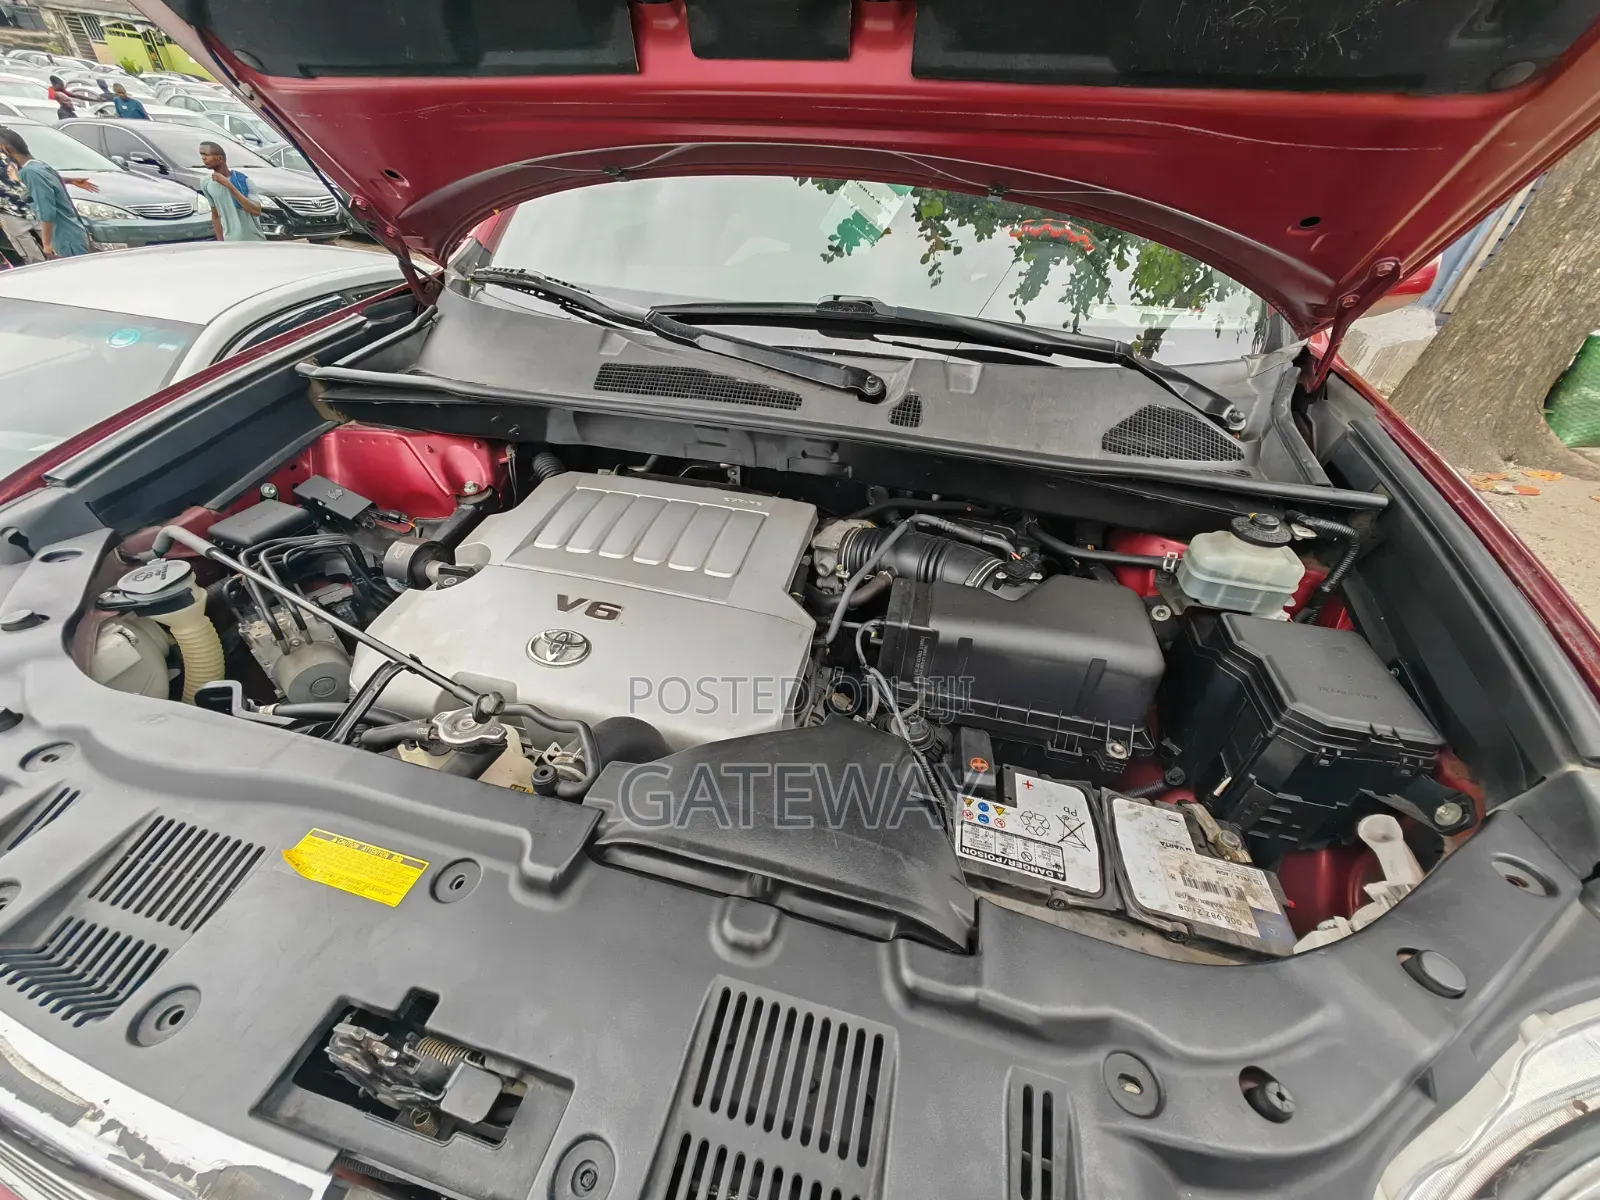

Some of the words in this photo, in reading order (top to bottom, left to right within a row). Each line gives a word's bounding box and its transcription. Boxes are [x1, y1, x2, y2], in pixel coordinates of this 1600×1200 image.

[557, 593, 624, 621] V6
[1063, 806, 1078, 817] Pb
[337, 838, 359, 849] CAUTION
[361, 845, 391, 859] ATTENTION
[962, 846, 1054, 877] DANGER/POISON
[1178, 903, 1191, 913] 08
[1206, 911, 1222, 921] 982
[1225, 915, 1242, 926] 000
